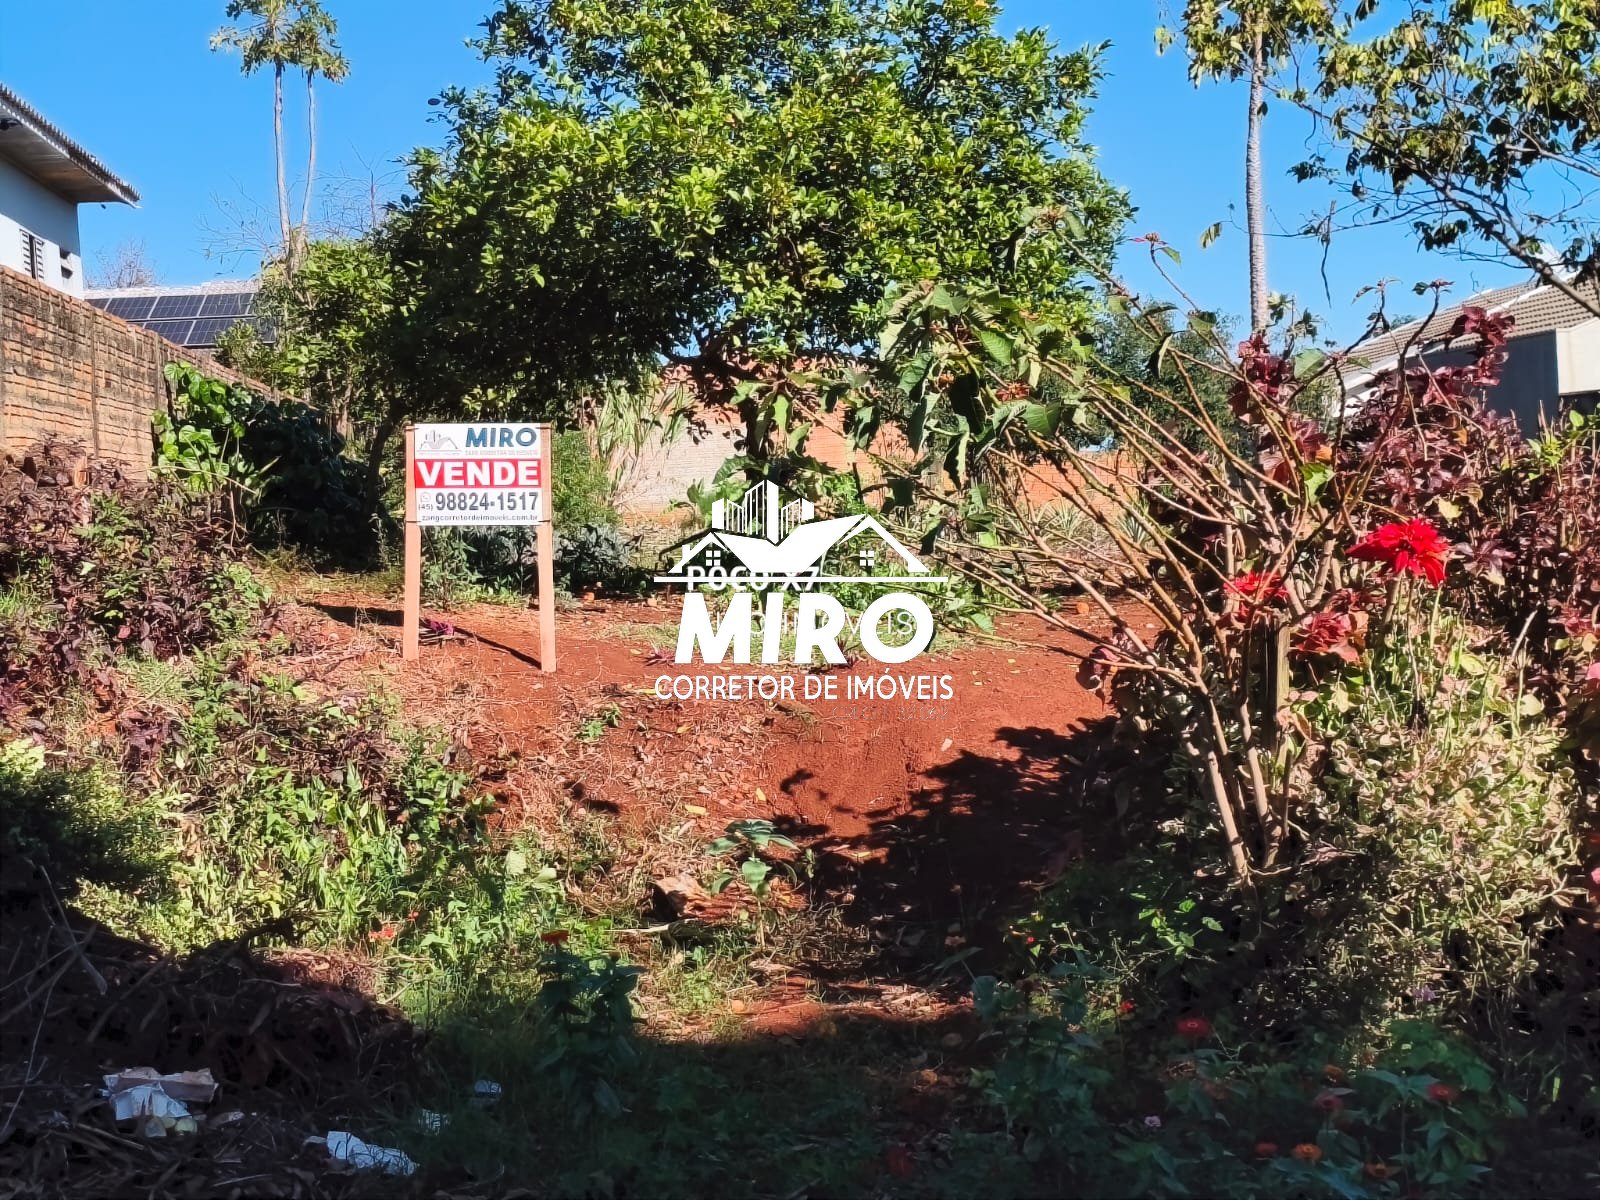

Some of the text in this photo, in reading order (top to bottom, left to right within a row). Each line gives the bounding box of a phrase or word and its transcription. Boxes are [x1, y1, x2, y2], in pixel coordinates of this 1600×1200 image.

[465, 427, 537, 447] MIRO
[416, 461, 539, 486] VENDE
[418, 492, 539, 511] (45) 98824-1517
